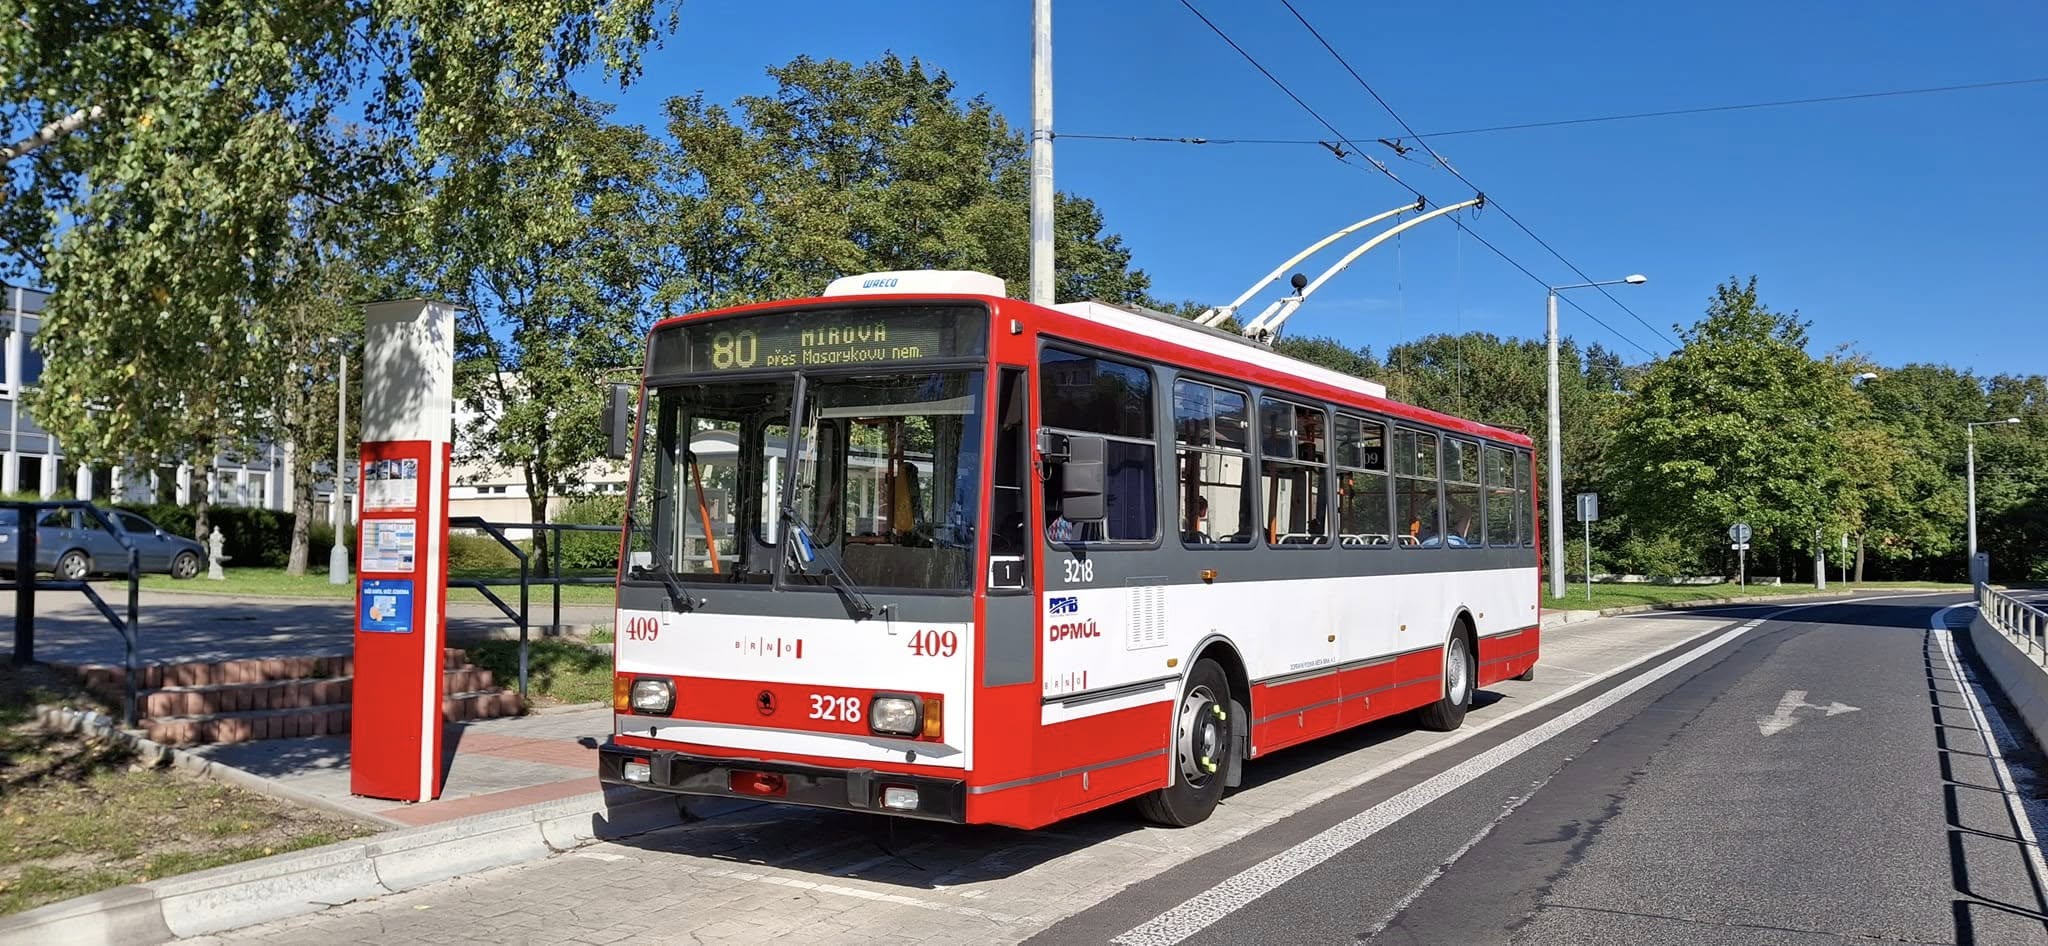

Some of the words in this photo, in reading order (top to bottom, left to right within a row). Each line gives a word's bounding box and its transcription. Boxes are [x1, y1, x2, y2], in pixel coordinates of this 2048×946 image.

[863, 278, 898, 288] WAECO
[711, 330, 757, 369] 80
[802, 345, 886, 364] Masarykovu
[891, 345, 923, 359] nem.
[1004, 565, 1010, 580] 1
[1063, 558, 1094, 583] 3218
[626, 616, 659, 642] 409
[1049, 617, 1101, 642] DPMÚL
[907, 629, 958, 658] 409
[809, 693, 861, 723] 3218
